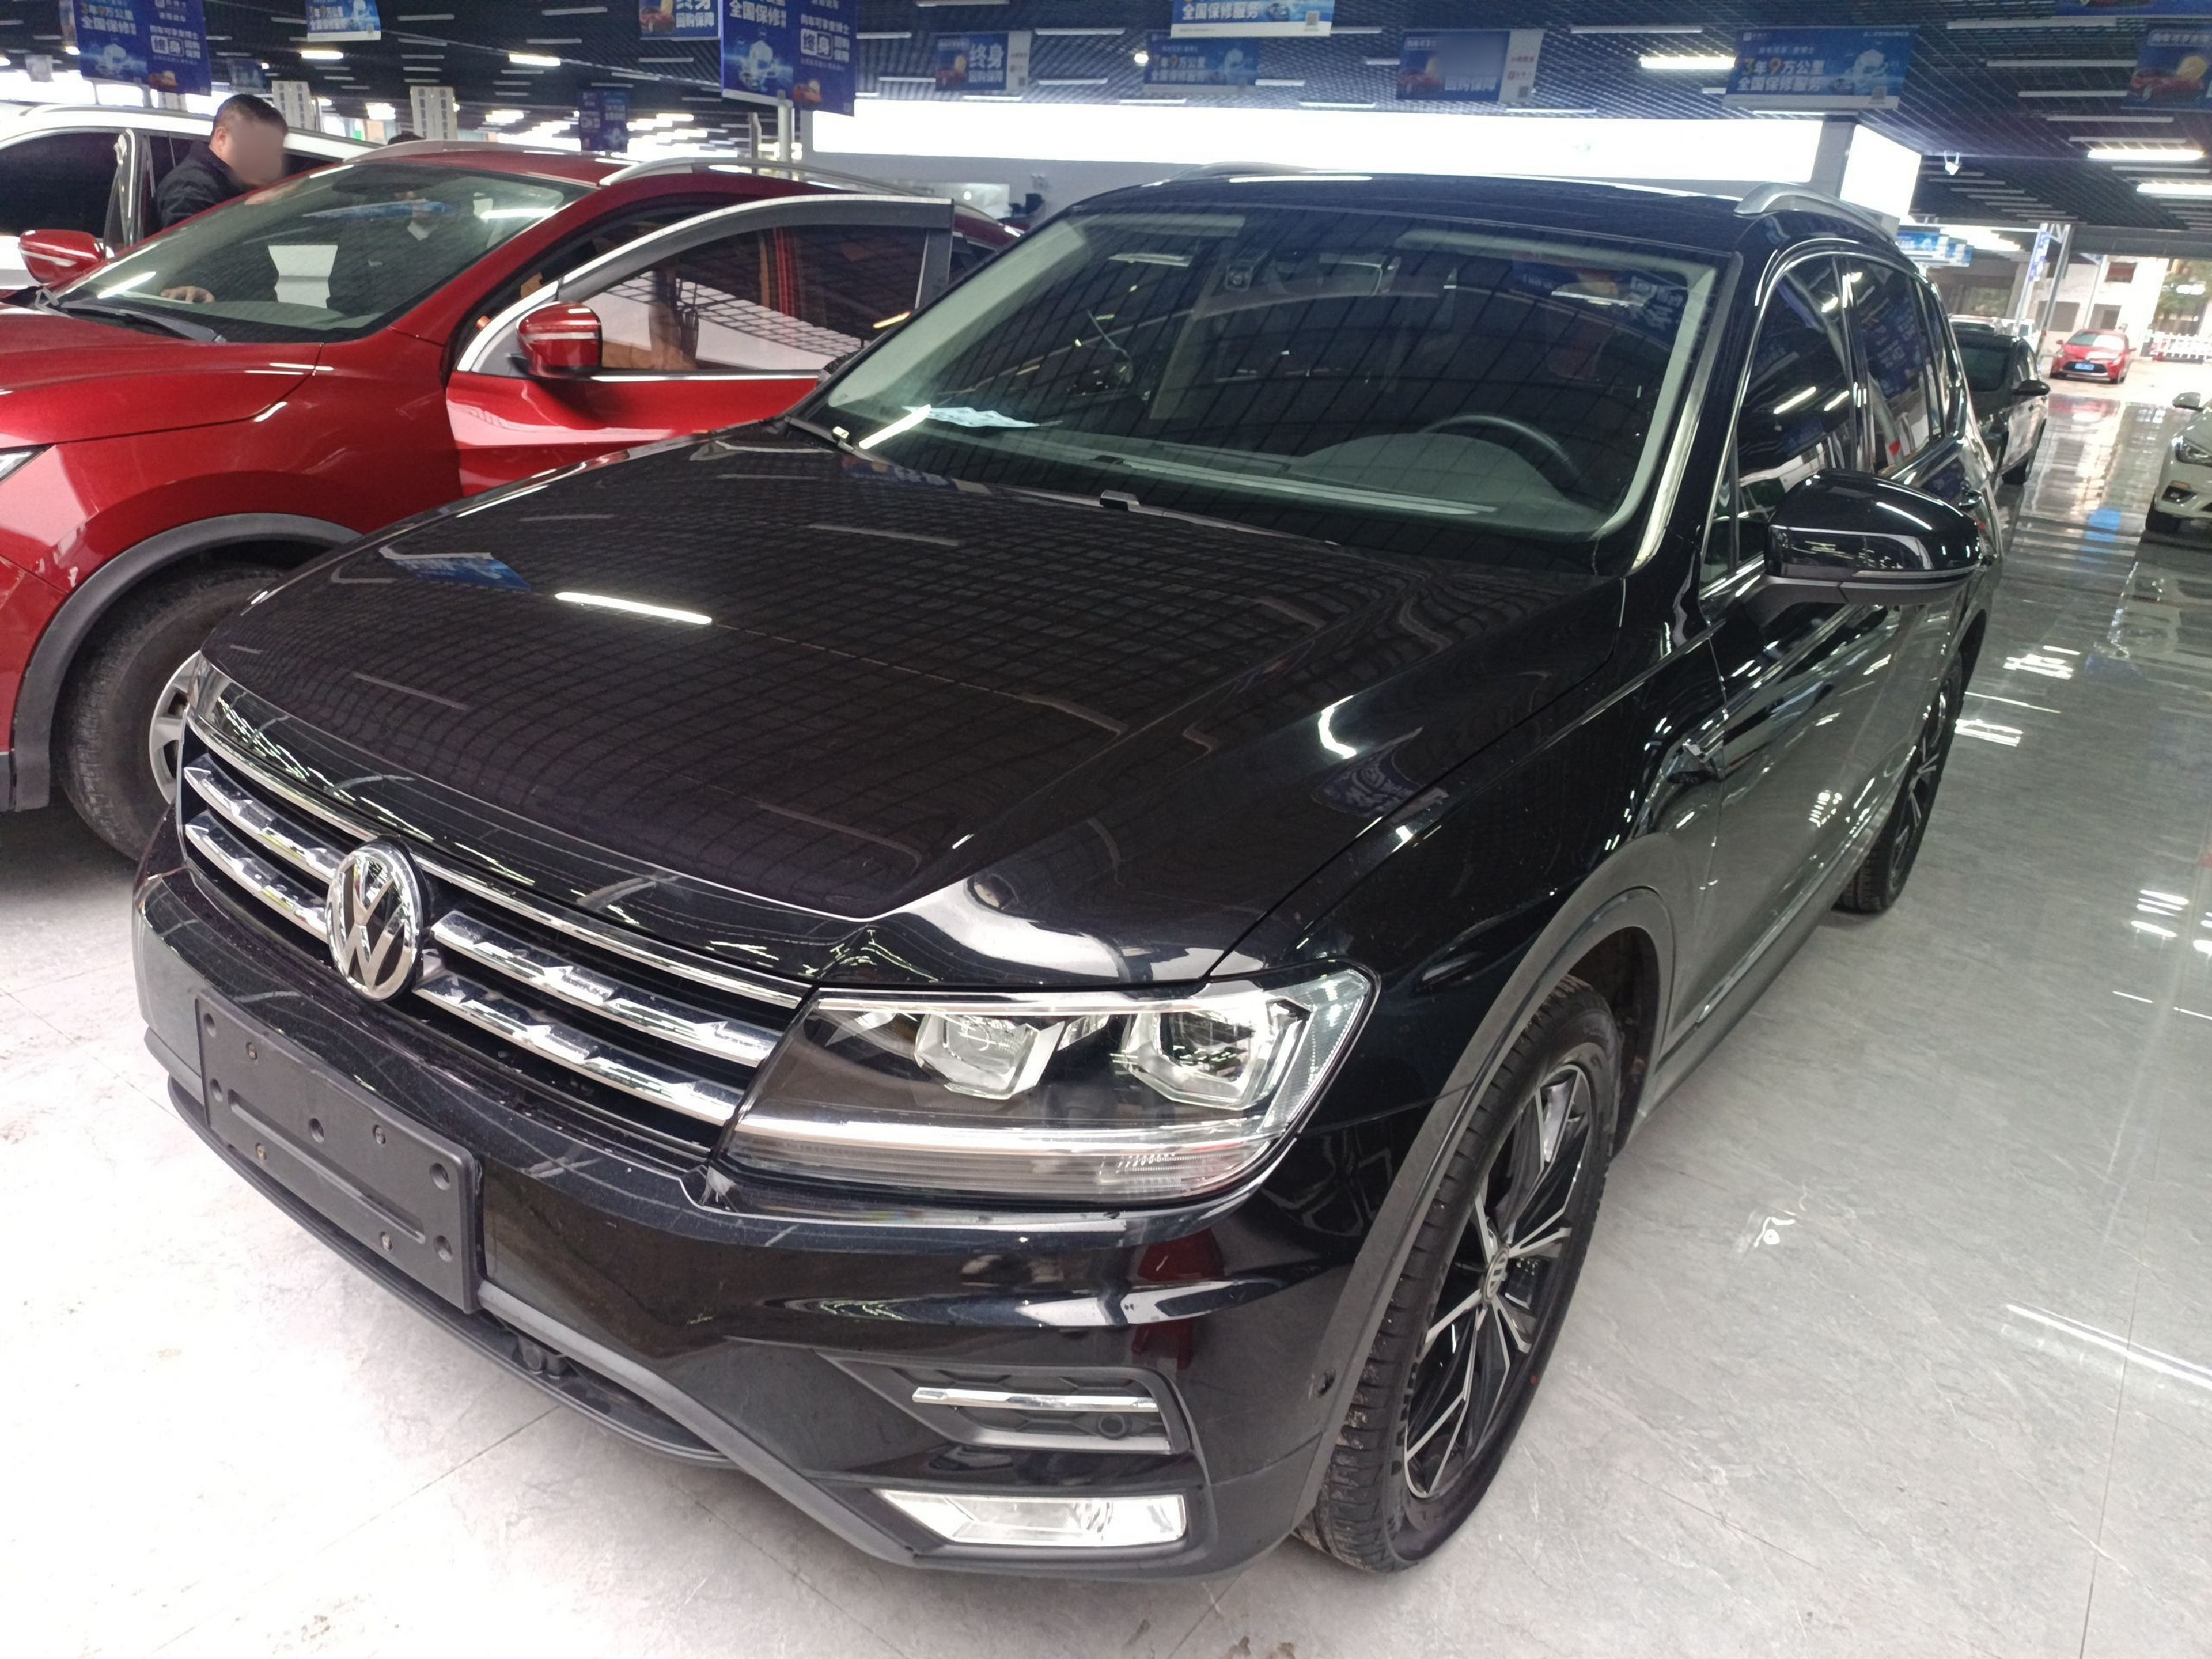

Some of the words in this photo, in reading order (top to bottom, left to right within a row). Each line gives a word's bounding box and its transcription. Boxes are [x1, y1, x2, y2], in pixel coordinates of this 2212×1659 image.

[1182, 2, 1260, 20] 全国保修服务
[969, 43, 1004, 68] 终身
[1741, 58, 1825, 75] 3年9万公里
